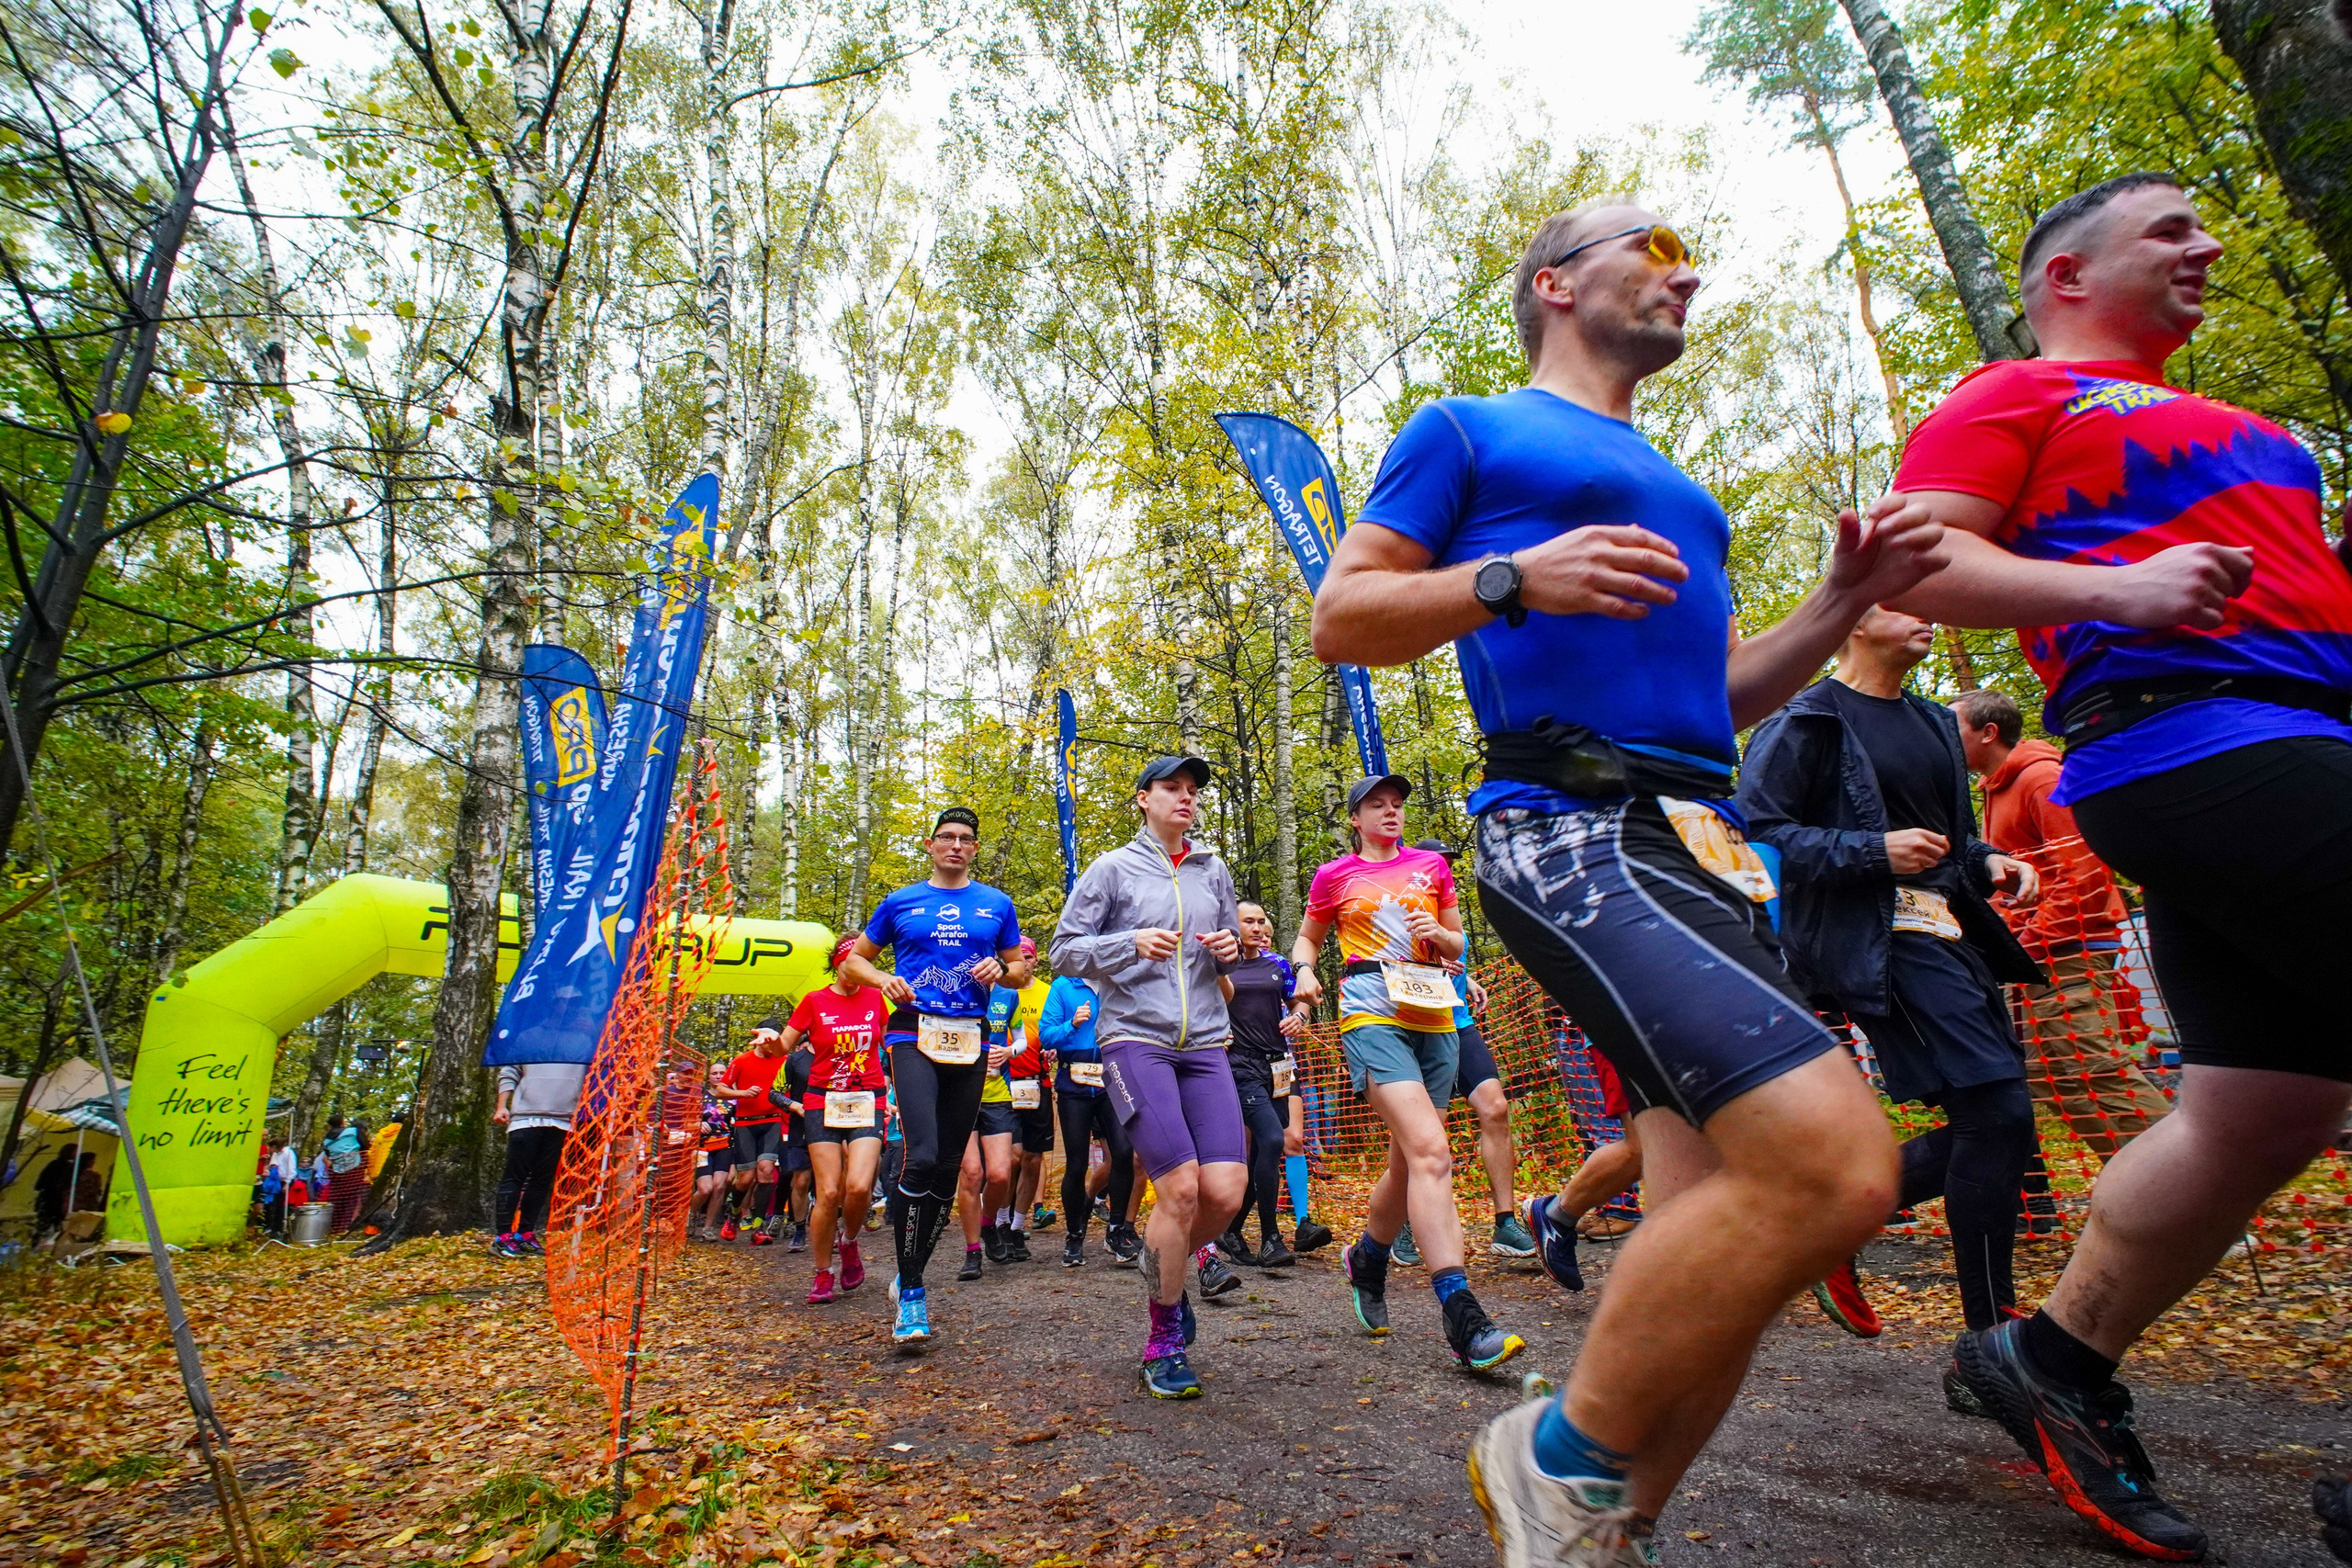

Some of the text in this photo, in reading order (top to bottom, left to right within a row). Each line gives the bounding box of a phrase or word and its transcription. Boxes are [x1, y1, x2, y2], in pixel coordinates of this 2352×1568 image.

[930, 931, 968, 939] Marafon
[937, 939, 962, 947] TRAIL
[1402, 981, 1434, 995] 103
[831, 1024, 872, 1033] МАРАФОН
[941, 1032, 958, 1044] 35
[938, 1044, 960, 1053] Вадим
[176, 1053, 249, 1081] Feel
[1087, 1065, 1099, 1073] 79
[157, 1087, 251, 1116] there's
[846, 1103, 853, 1113] 1
[138, 1118, 253, 1150] no limit
